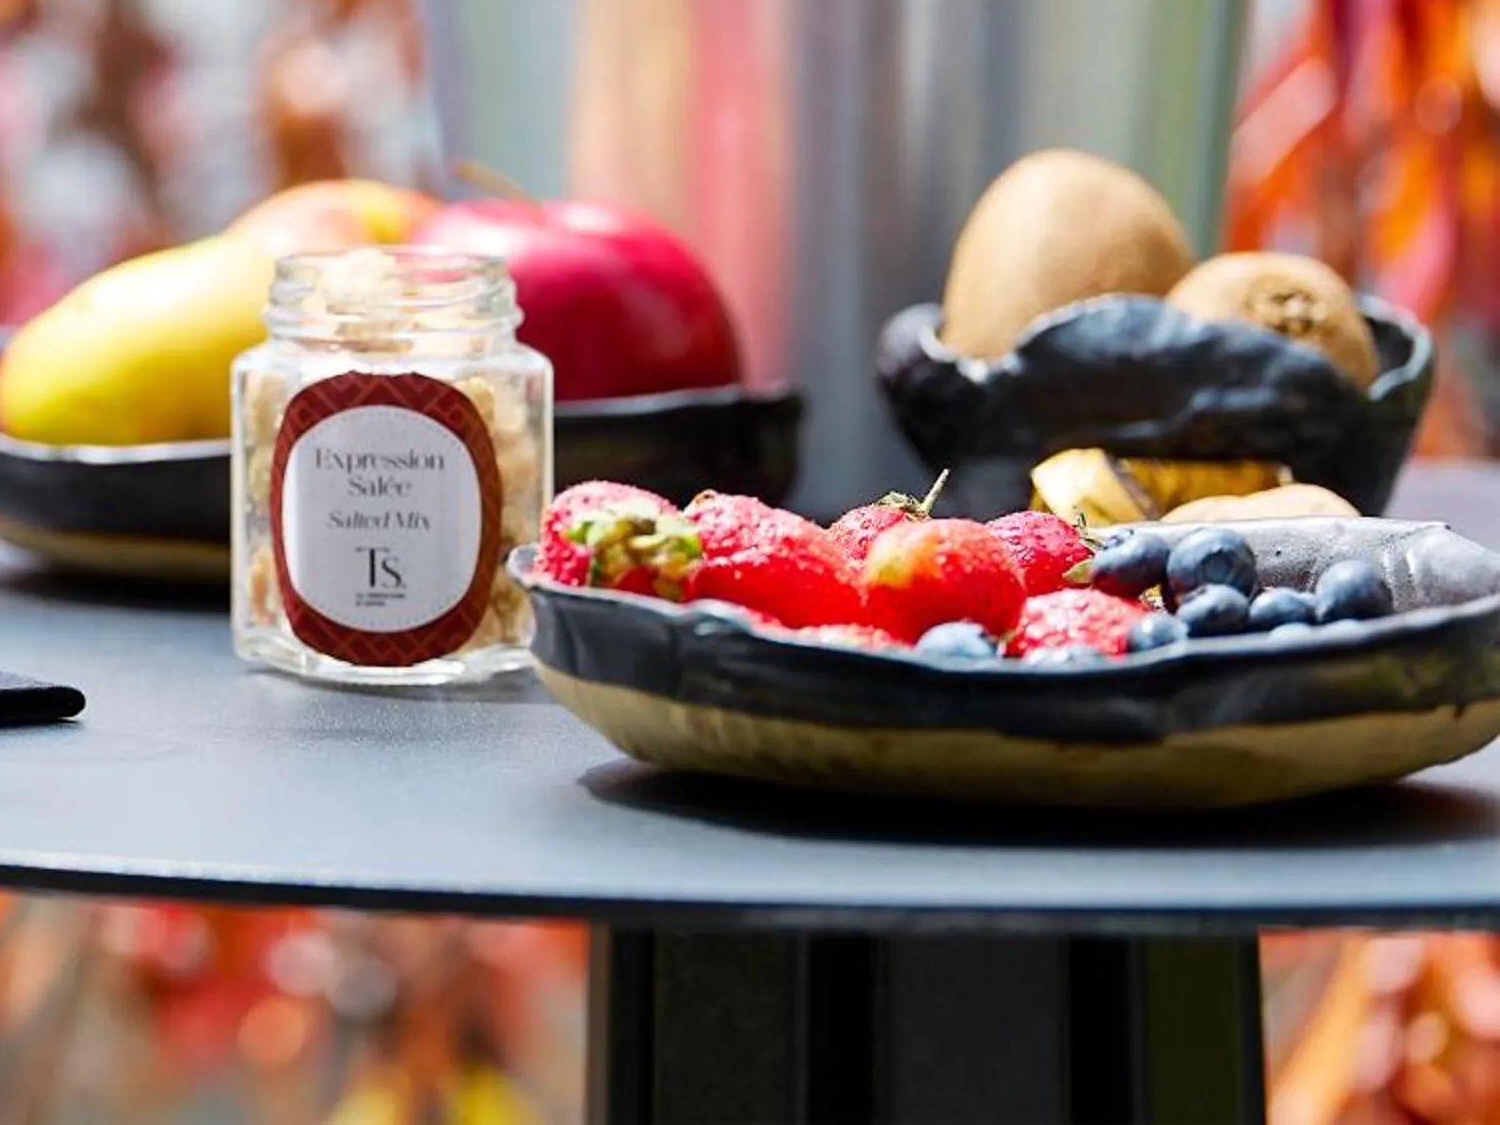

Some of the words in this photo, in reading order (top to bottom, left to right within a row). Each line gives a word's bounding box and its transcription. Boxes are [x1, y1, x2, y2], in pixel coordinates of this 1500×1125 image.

[315, 447, 445, 475] Expression
[347, 475, 413, 496] Salée
[327, 510, 390, 529] Salted
[394, 511, 430, 530] Mix
